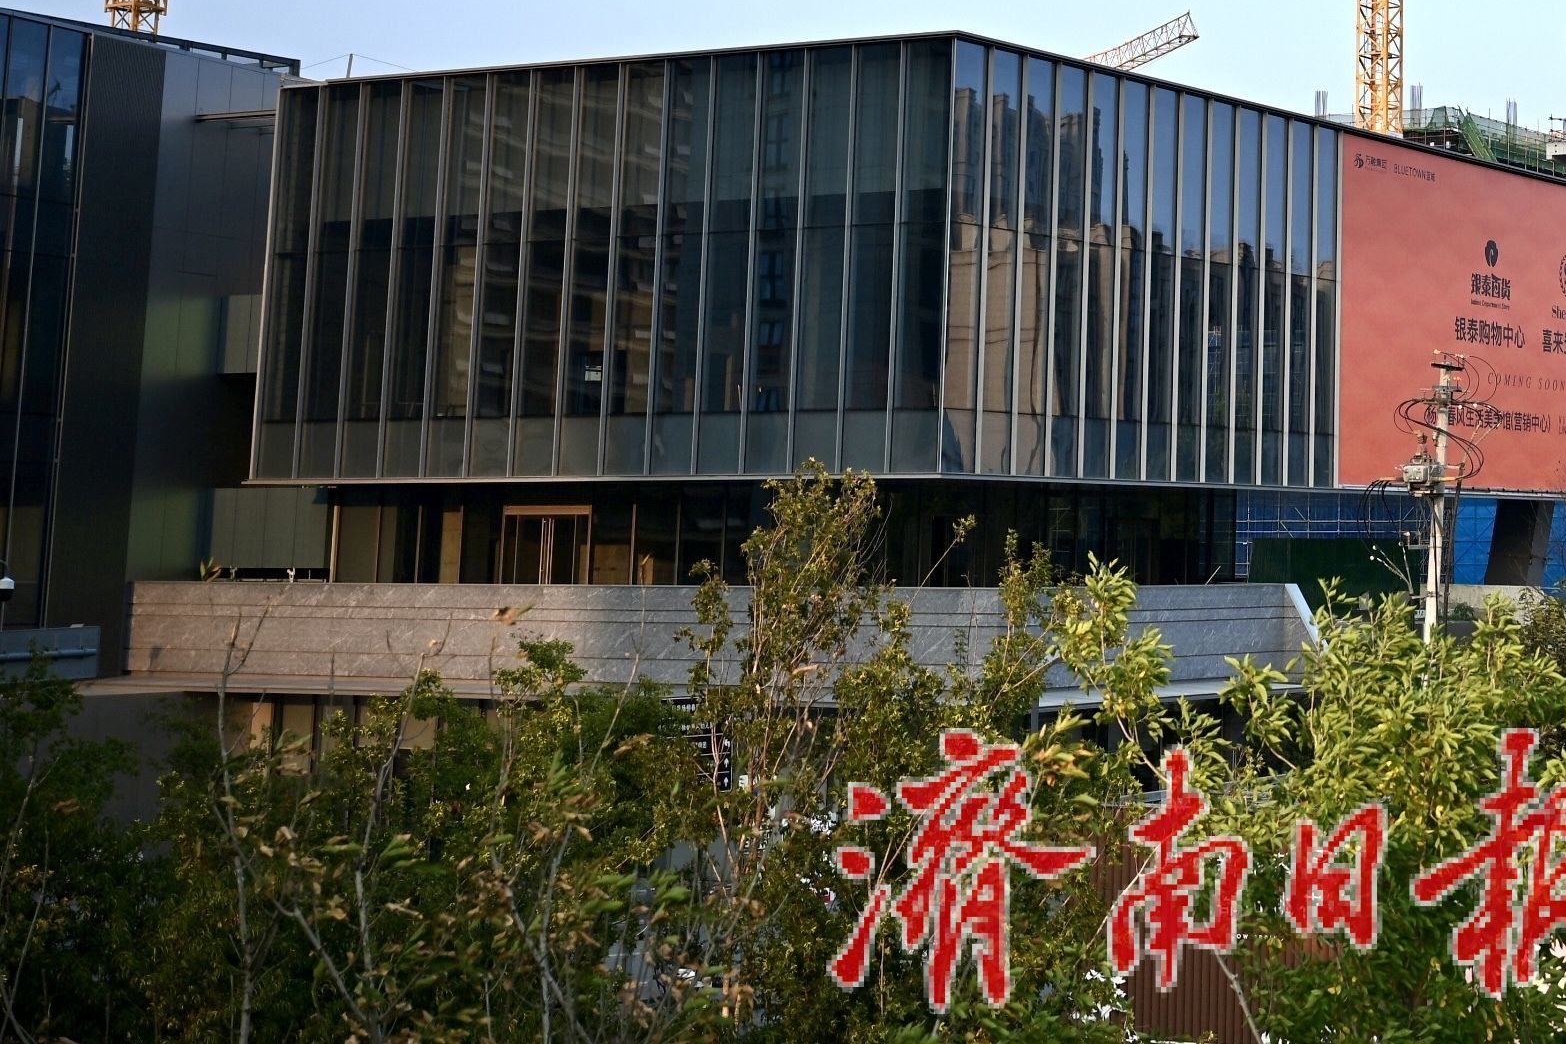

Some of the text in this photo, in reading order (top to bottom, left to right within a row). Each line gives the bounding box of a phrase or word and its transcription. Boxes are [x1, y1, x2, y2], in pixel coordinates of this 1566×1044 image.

[1471, 272, 1511, 301] 银泰百货
[1454, 315, 1526, 349] 银泰购物中心
[1487, 372, 1566, 392] COMING SOON
